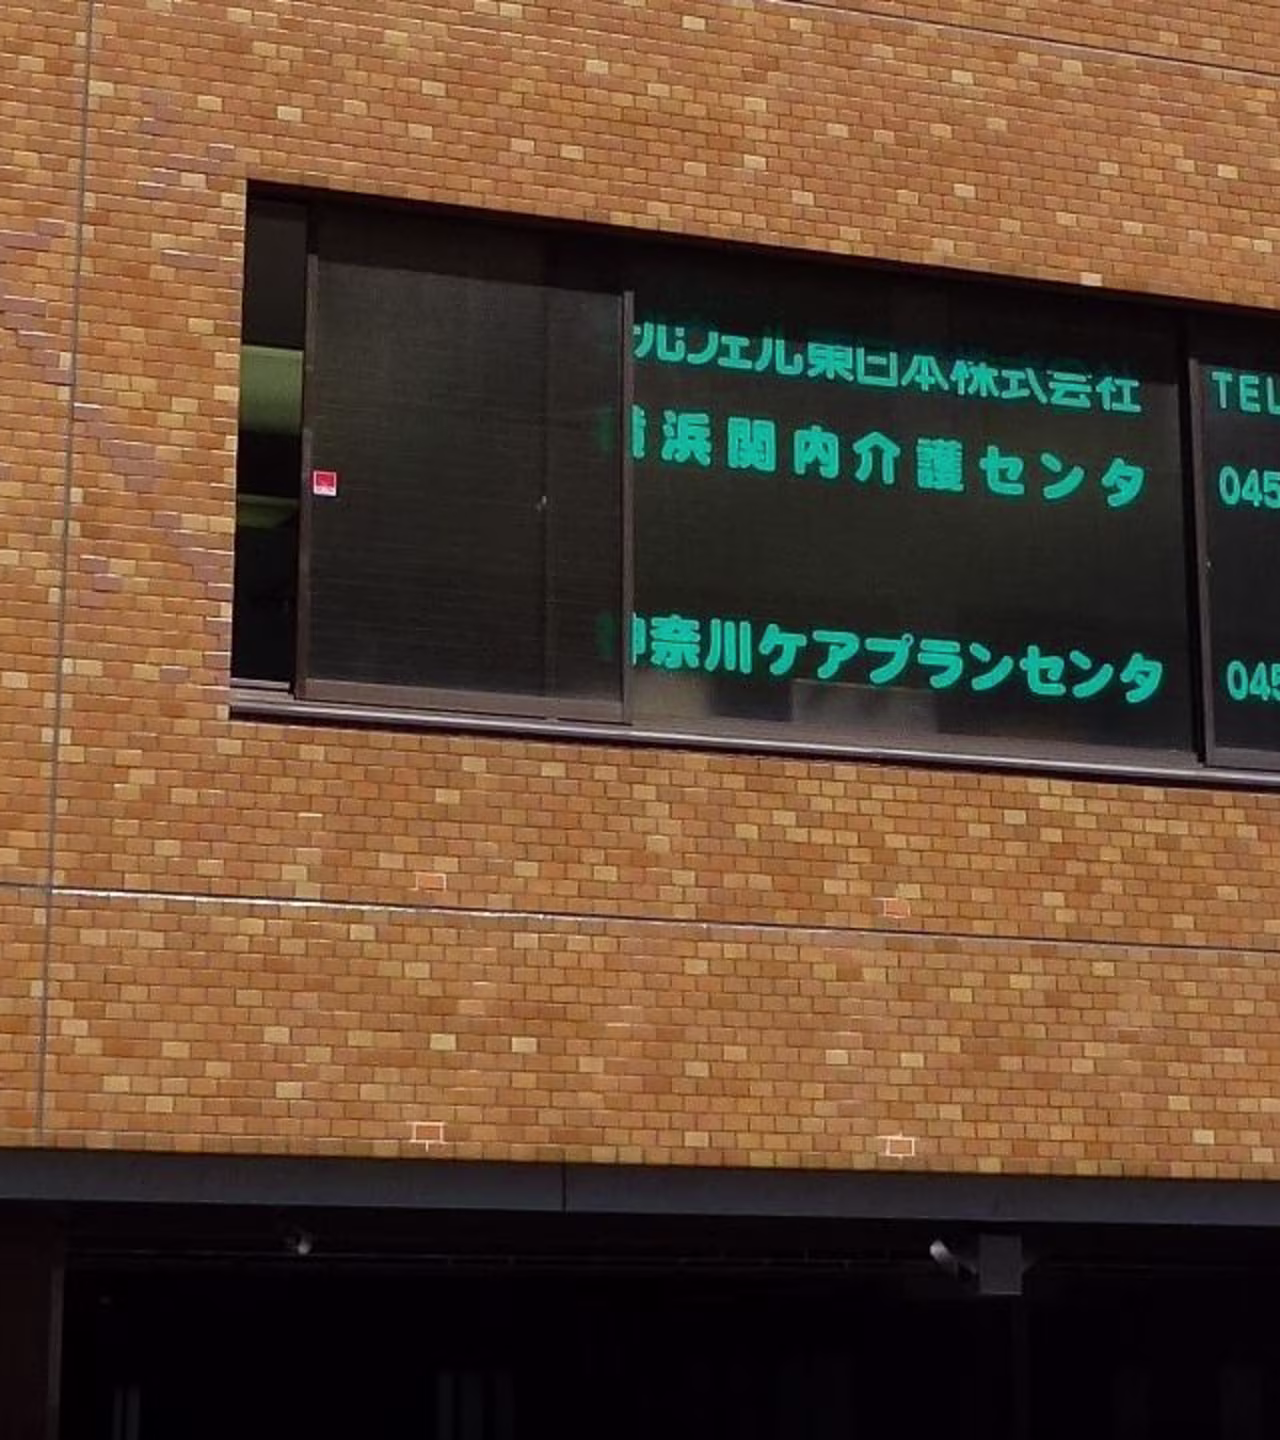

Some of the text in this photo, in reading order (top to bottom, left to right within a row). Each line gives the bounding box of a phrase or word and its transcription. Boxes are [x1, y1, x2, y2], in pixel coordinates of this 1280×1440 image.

[632, 322, 1138, 412] ルシェル東日本株式会社
